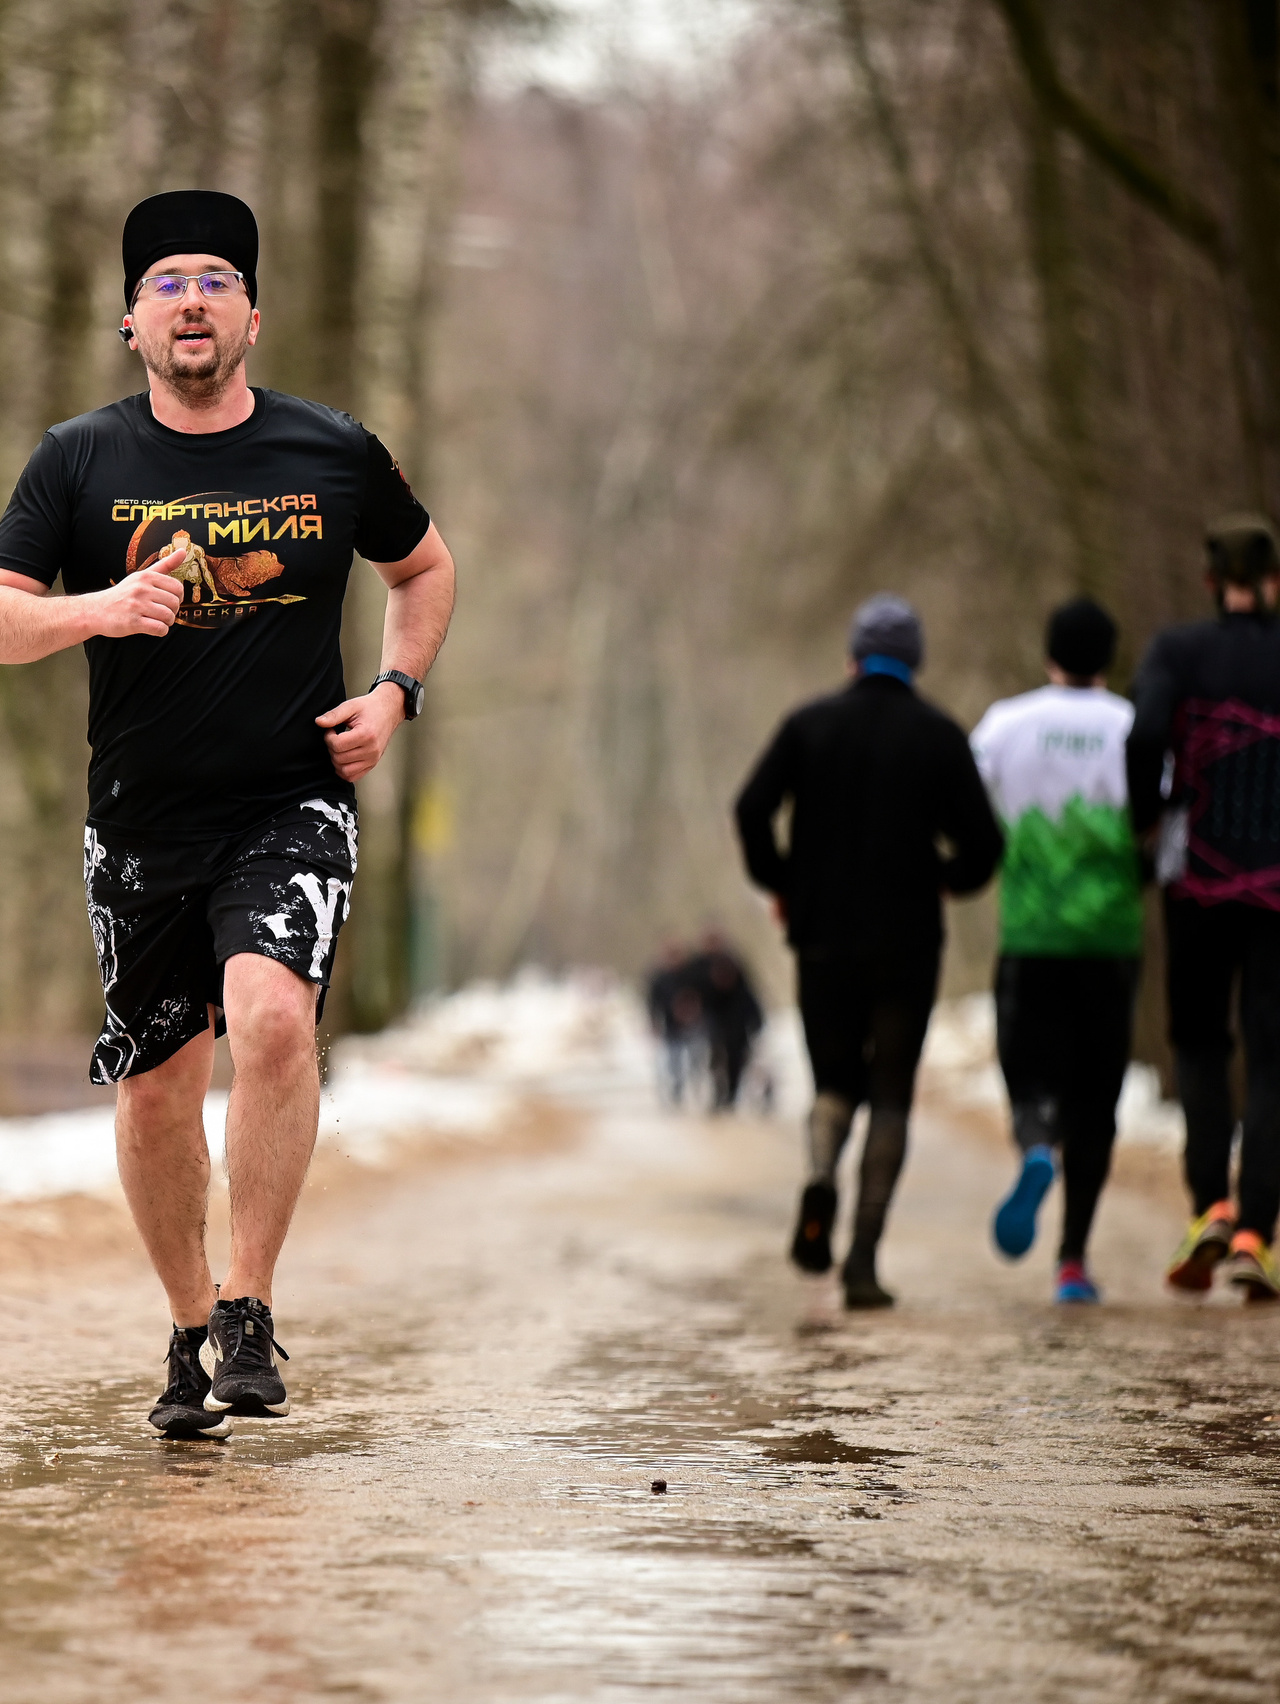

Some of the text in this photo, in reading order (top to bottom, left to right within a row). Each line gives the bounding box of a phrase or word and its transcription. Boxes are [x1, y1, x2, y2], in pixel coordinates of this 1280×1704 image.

[111, 493, 318, 523] СПАРТАНСКАЯ
[208, 514, 323, 546] МИЛЯ
[178, 605, 258, 617] МОСКВА
